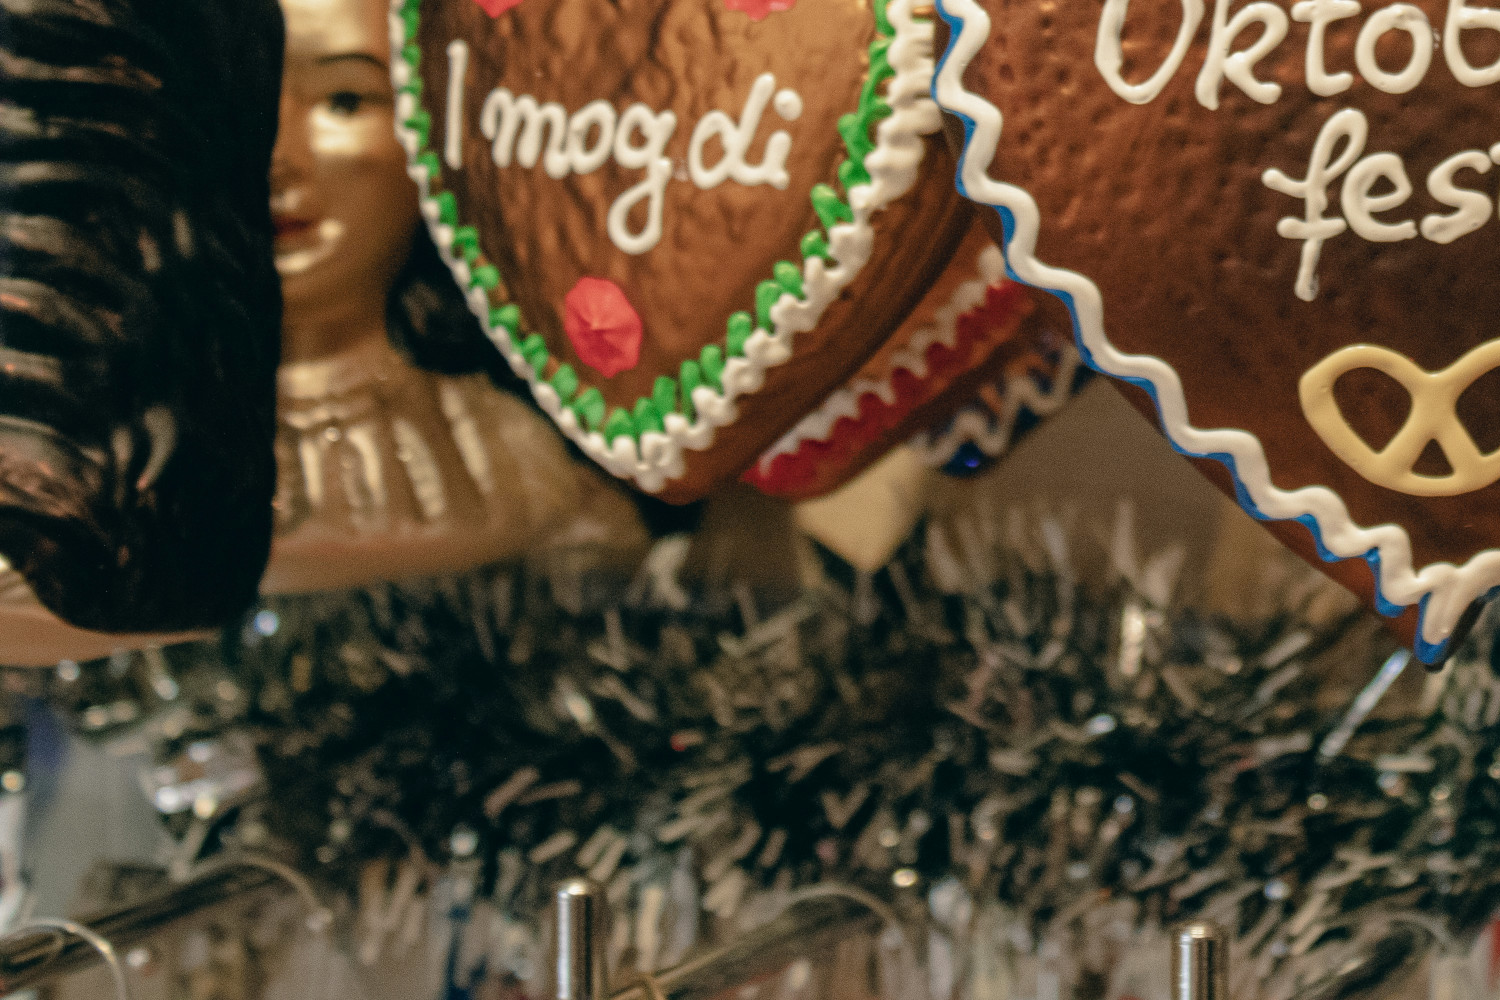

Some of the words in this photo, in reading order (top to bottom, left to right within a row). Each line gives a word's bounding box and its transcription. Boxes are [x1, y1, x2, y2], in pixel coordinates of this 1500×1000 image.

[445, 39, 468, 170] I
[480, 86, 677, 255] mog
[688, 72, 803, 189] di
